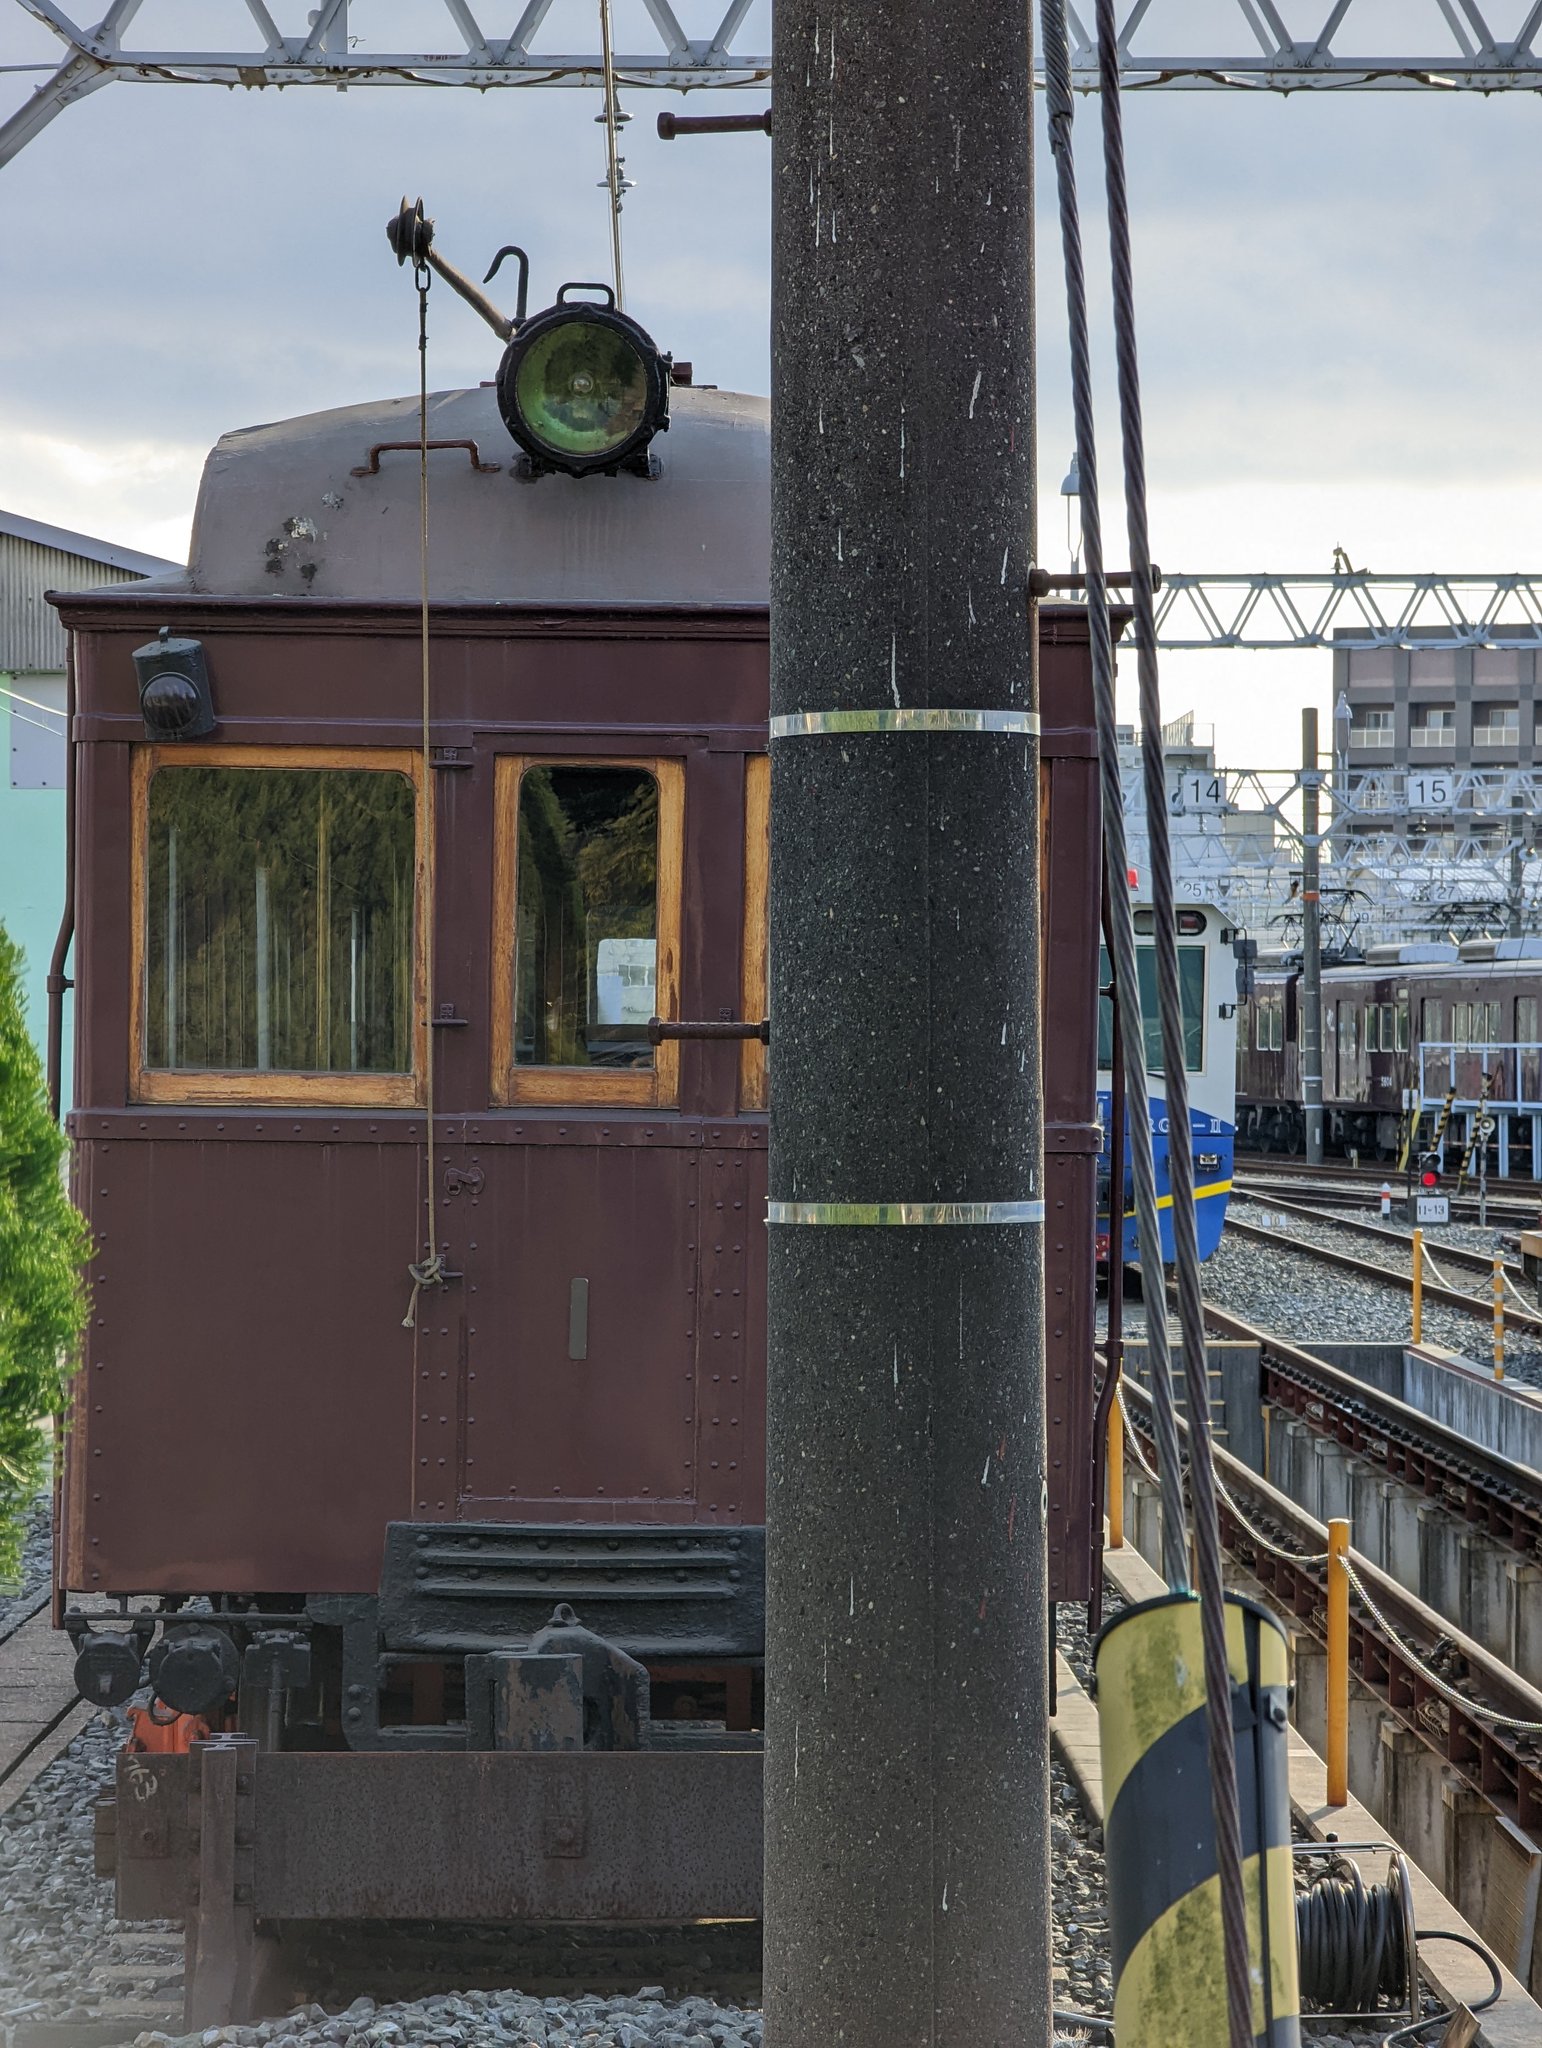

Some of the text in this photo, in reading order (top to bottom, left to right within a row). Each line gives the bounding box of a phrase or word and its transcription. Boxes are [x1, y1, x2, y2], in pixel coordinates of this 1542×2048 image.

[1190, 779, 1221, 803] 14
[1416, 780, 1446, 803] 15
[1183, 882, 1202, 897] 25
[1436, 886, 1455, 900] 27
[1418, 1204, 1445, 1216] 11-13
